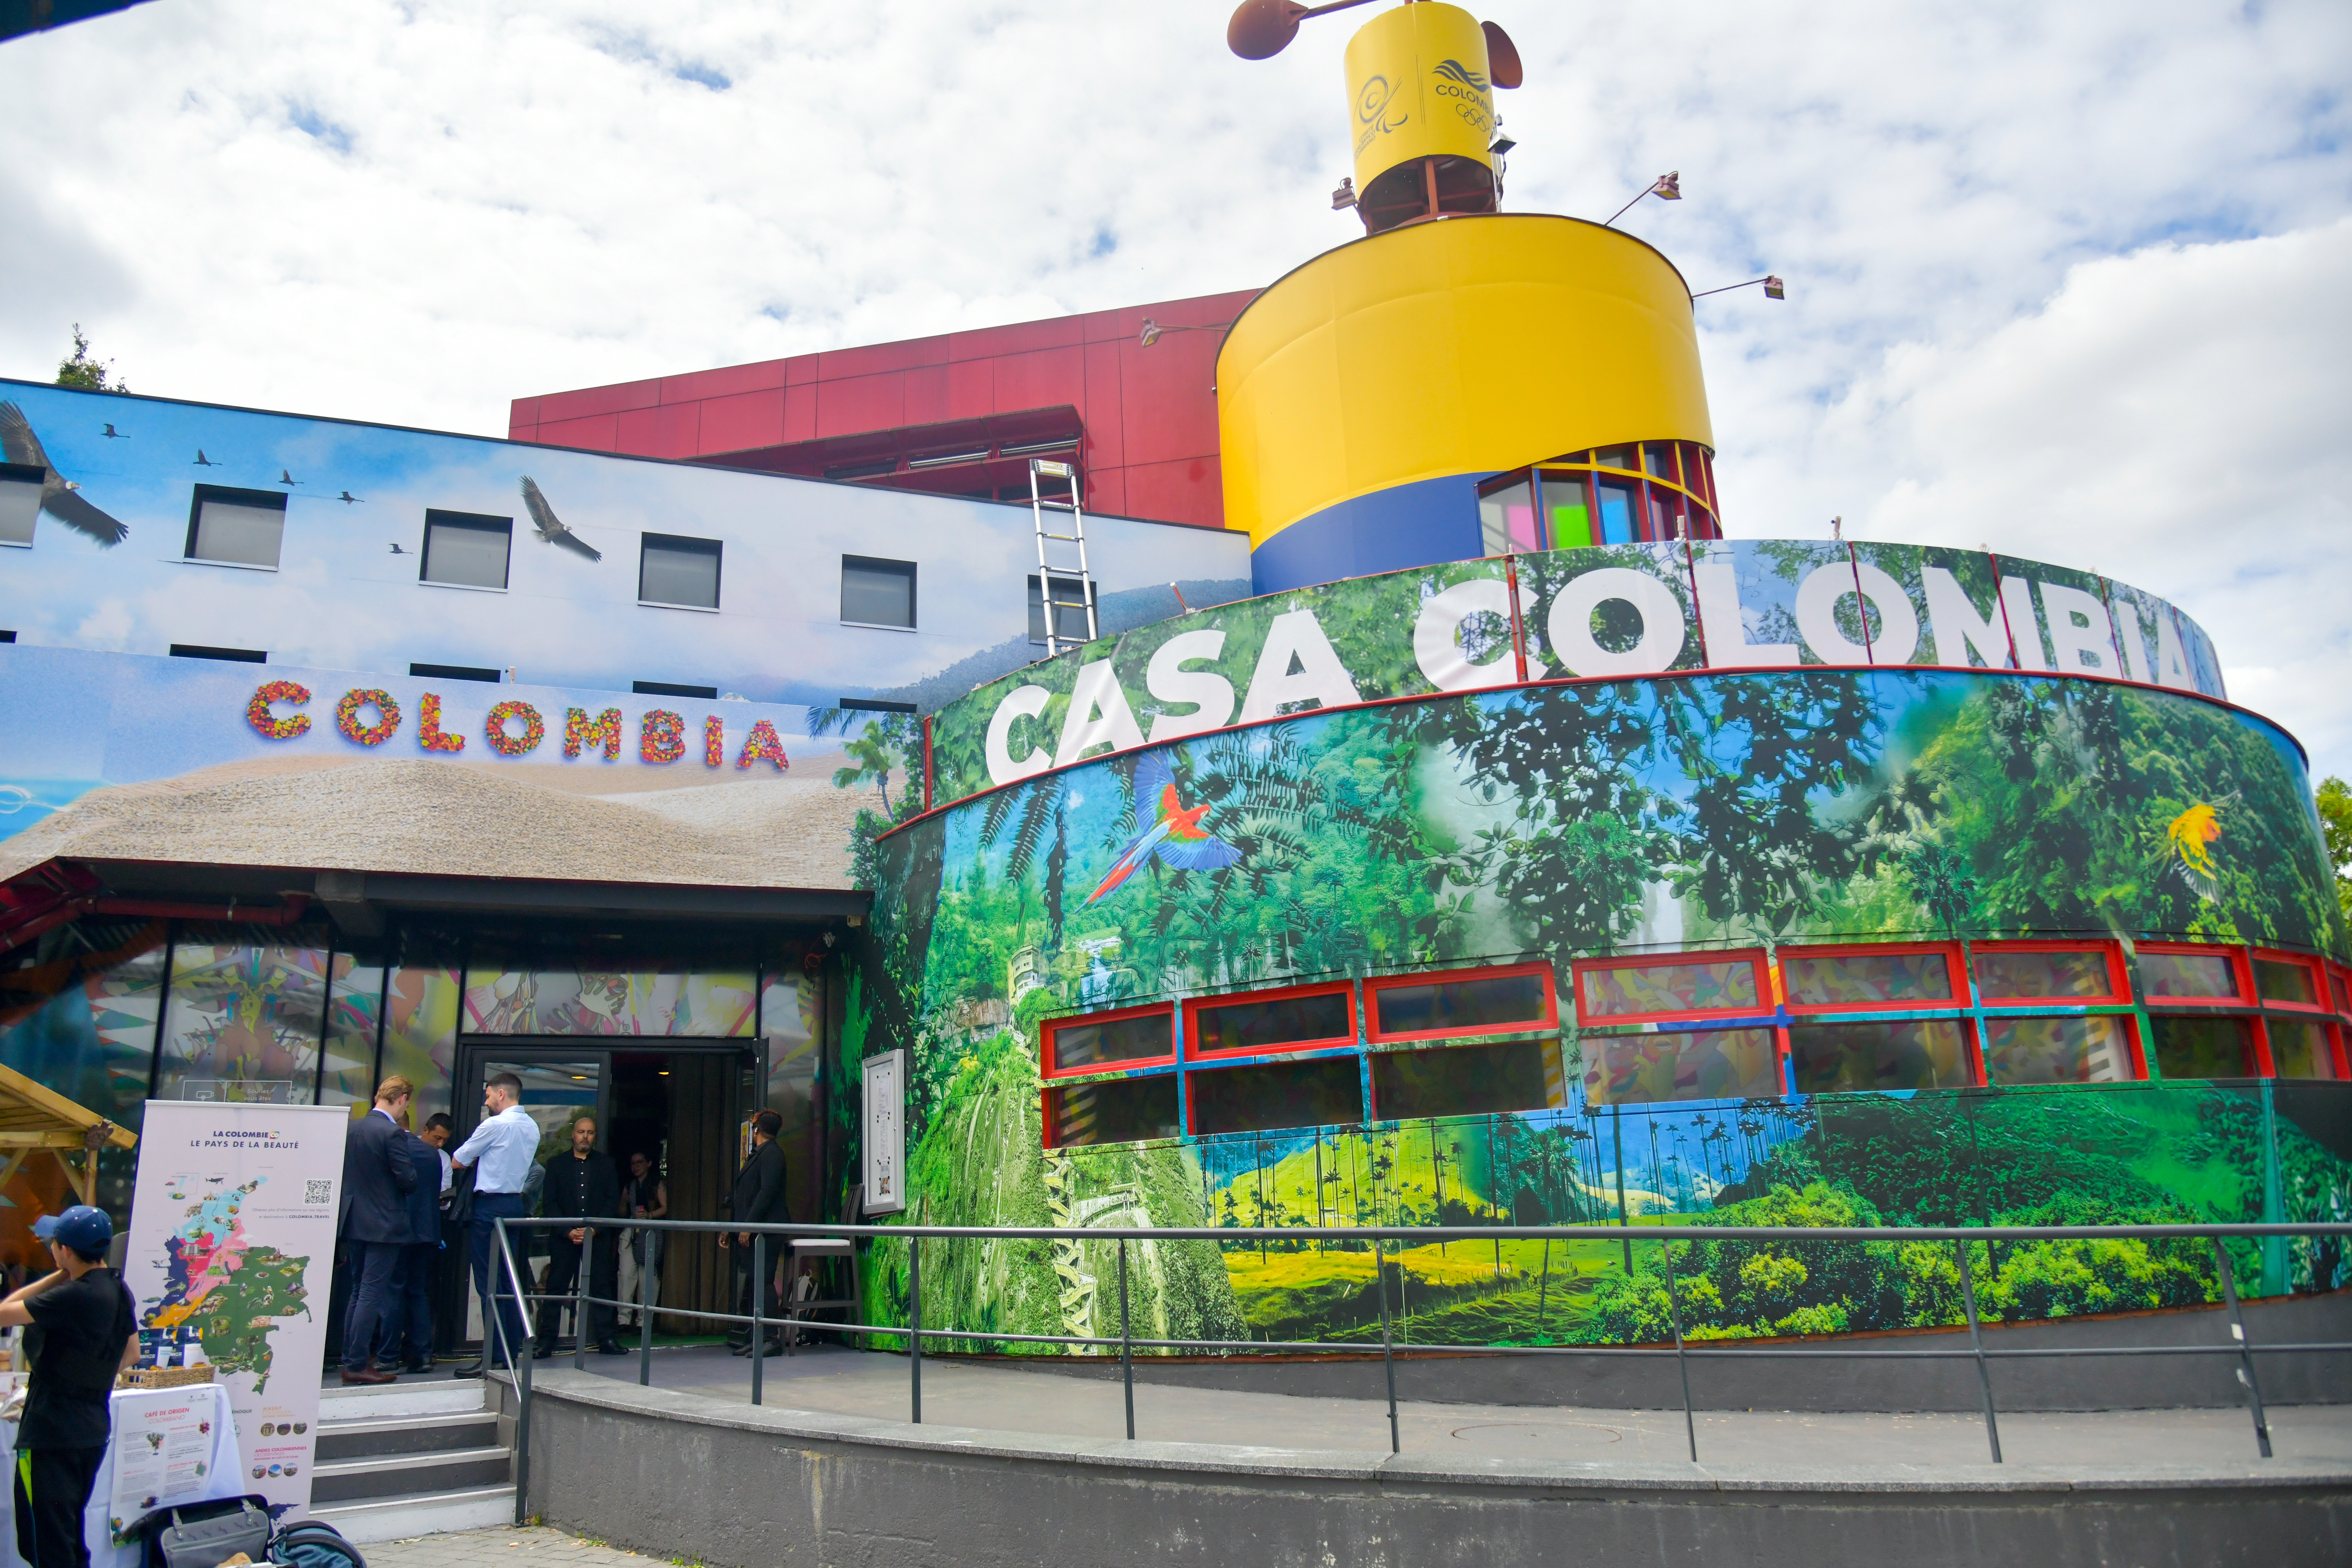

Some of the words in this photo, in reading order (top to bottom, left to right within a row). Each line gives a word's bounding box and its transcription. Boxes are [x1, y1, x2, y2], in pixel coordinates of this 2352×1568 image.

[1436, 85, 1494, 119] COLOMBIA
[985, 609, 1362, 786] CASA
[1414, 565, 2198, 693] COLOMBIA
[247, 680, 790, 771] COLOMBIA
[149, 1415, 185, 1424] COLOMBIANO
